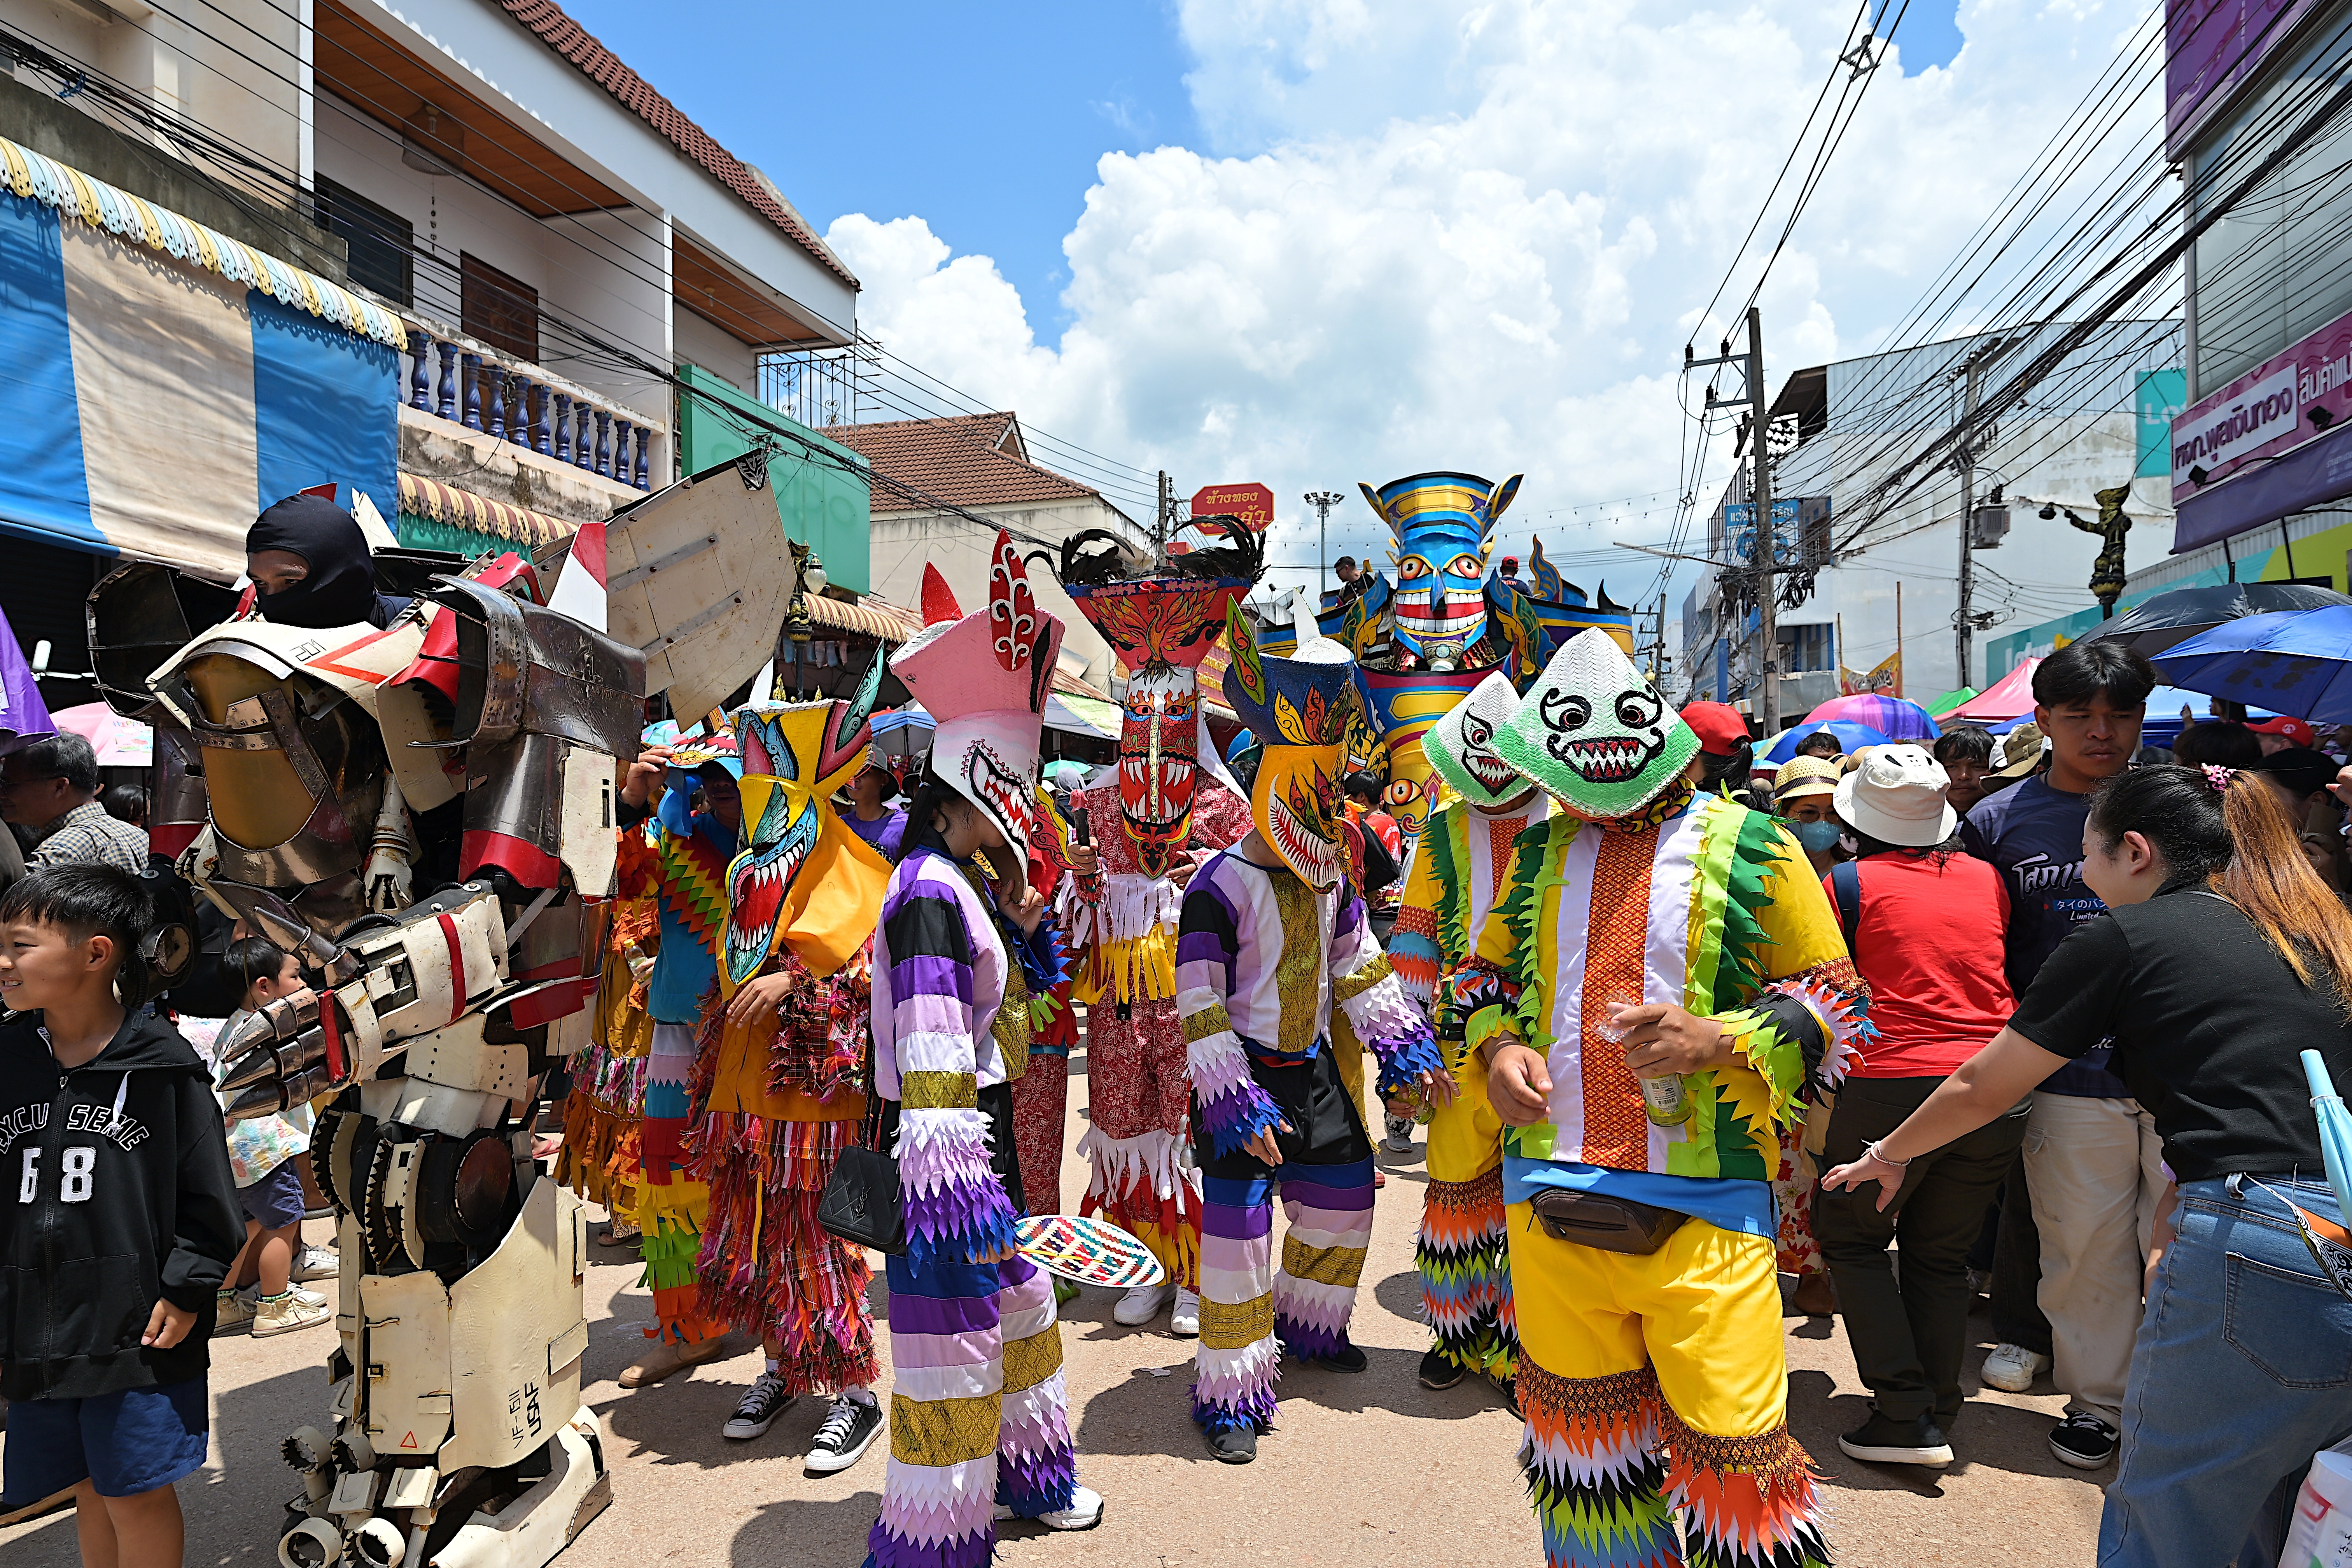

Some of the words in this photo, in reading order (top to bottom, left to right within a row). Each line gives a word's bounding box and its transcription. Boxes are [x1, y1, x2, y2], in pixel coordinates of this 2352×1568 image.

[2144, 401, 2186, 425] Lo
[1206, 490, 1258, 504] ห้างทอง
[289, 639, 327, 662] 201
[524, 1381, 542, 1437] USAF
